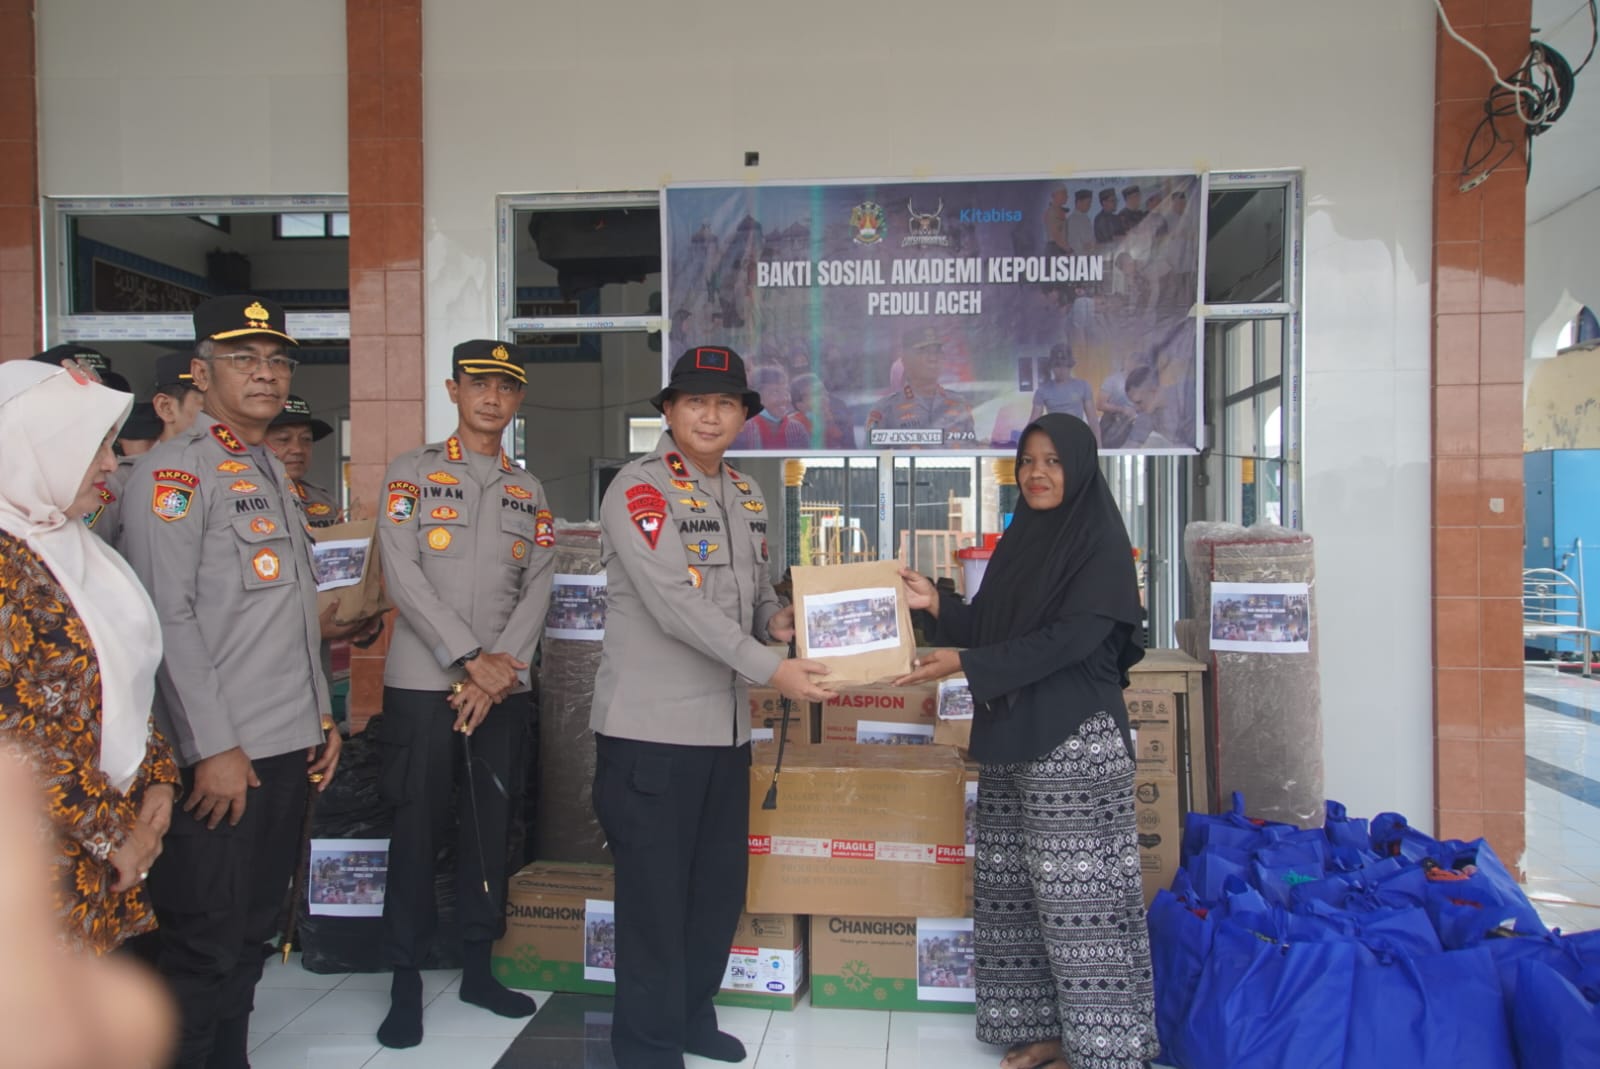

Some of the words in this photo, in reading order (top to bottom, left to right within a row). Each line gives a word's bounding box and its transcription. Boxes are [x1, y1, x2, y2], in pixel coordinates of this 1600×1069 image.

[960, 208, 1022, 223] Kitabisa
[756, 260, 812, 288] BAKTI
[817, 259, 885, 286] SOSIAL
[891, 257, 982, 285] AKADEMI
[988, 254, 1103, 283] KEPOLISIAN
[867, 291, 928, 317] PEDULI
[934, 290, 982, 315] ACEH
[158, 470, 194, 485] AKPOL
[389, 481, 420, 497] AKPOL
[423, 487, 465, 501] IWAN
[501, 496, 537, 517] POLRI
[826, 694, 906, 711] MASPION
[748, 837, 770, 847] AGILE
[833, 841, 874, 851] FRAGILE
[938, 847, 965, 857] FRAG
[829, 917, 917, 937] CHANGHON
